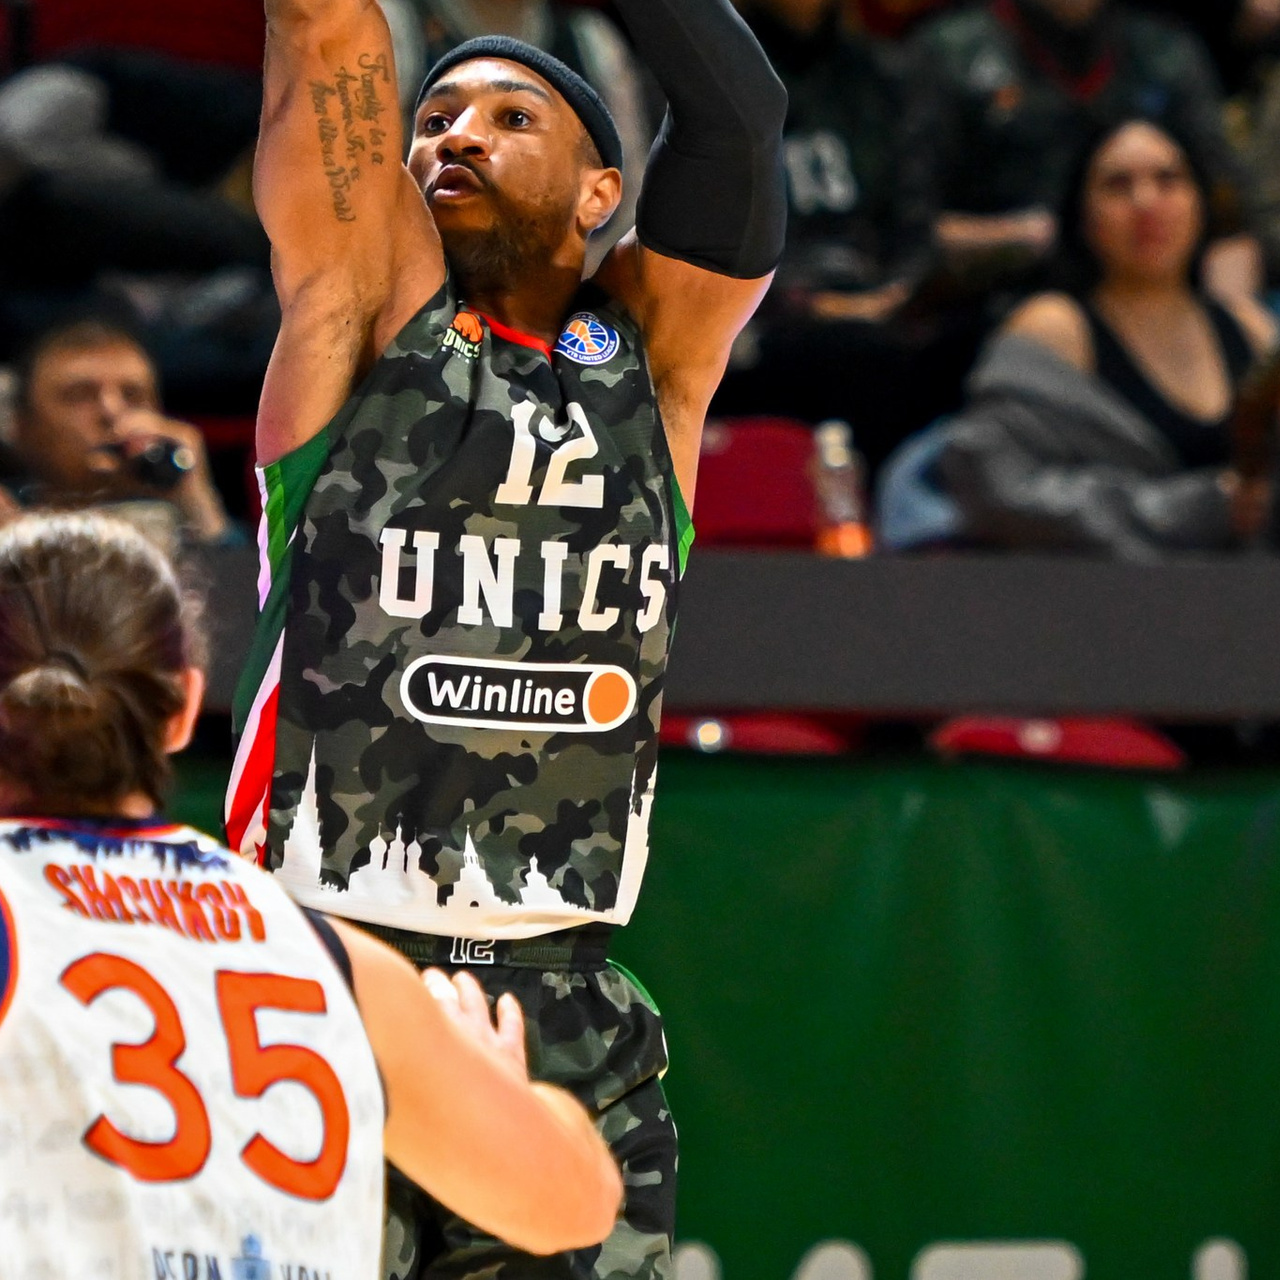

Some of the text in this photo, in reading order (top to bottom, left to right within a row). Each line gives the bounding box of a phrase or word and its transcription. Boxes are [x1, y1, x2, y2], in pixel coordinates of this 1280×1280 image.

[443, 328, 482, 358] UNICS
[566, 340, 616, 362] VTB UNITED LEAGUE
[494, 399, 604, 508] 12
[378, 527, 669, 634] UNICS
[427, 672, 576, 716] Winline
[59, 951, 350, 1203] 35
